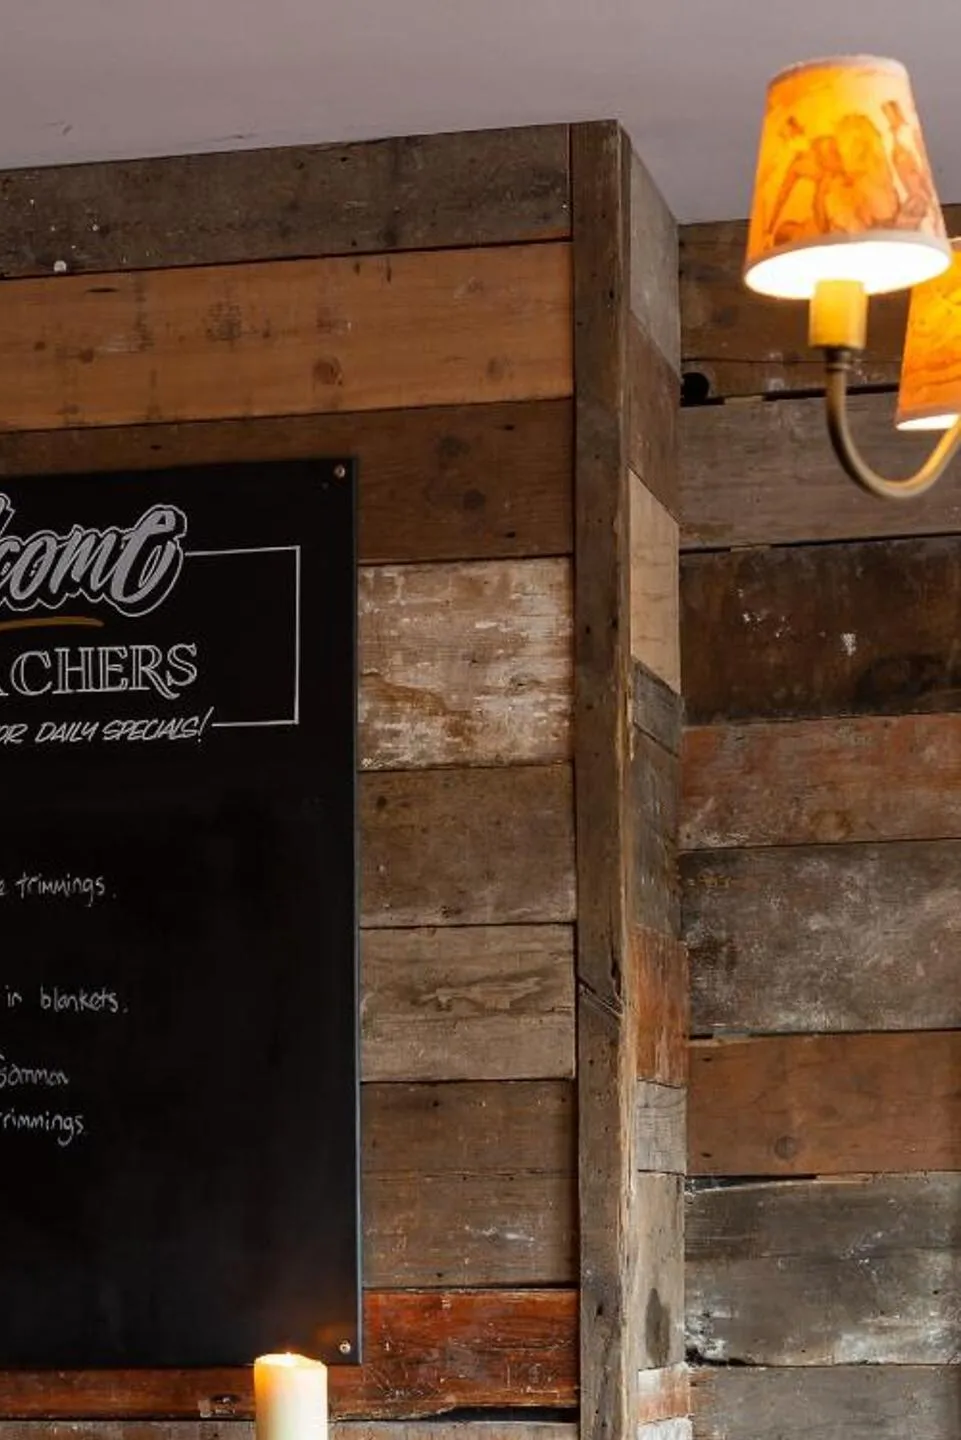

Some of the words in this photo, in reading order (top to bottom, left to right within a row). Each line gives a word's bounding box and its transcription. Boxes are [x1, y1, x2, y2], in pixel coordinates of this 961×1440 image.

[35, 721, 99, 743] DAILY
[101, 707, 214, 742] SPECIALS!
[5, 985, 23, 1008] in
